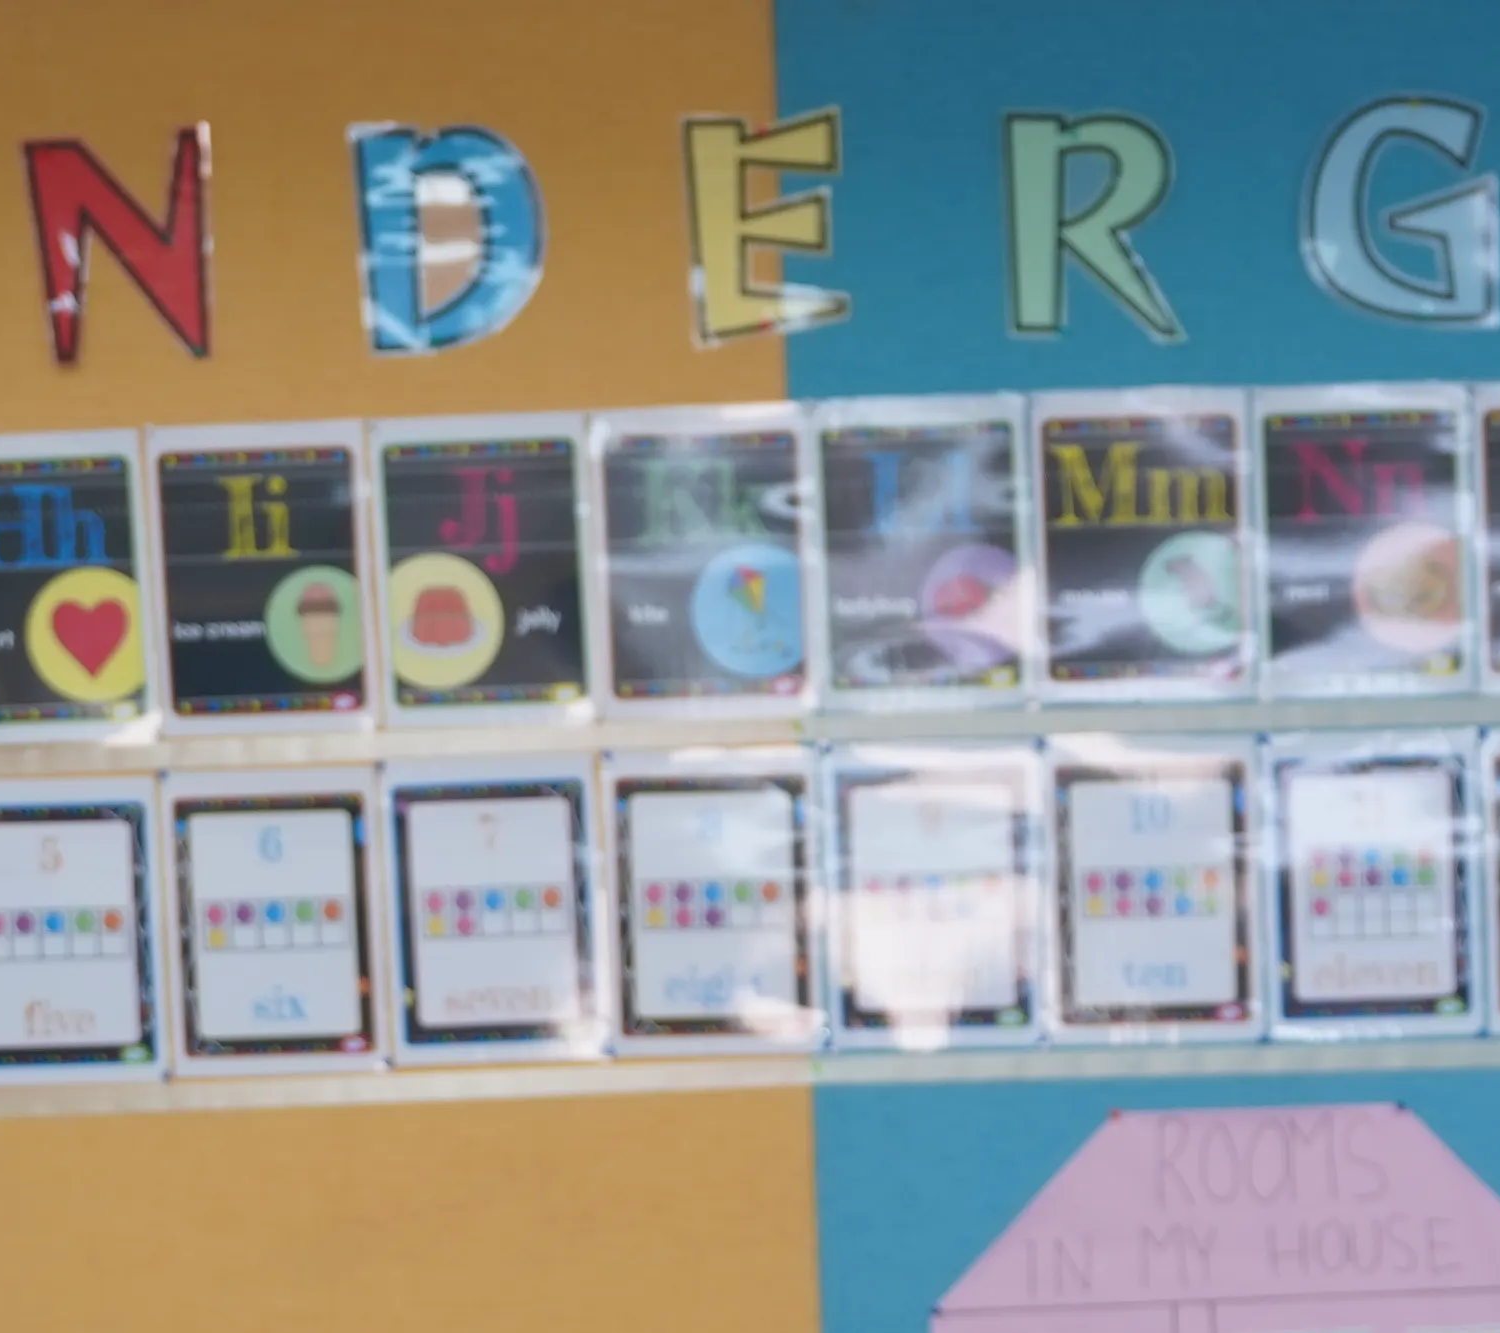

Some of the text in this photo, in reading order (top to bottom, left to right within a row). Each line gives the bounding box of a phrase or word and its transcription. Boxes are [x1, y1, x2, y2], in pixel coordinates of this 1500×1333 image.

[219, 476, 296, 559] Ii
[439, 469, 518, 574] Jj
[1049, 443, 1232, 527] Mm
[1293, 439, 1424, 522] Nn
[260, 827, 284, 863] 6
[1121, 958, 1188, 988] ten
[1157, 1112, 1389, 1208] ROOMS
[1026, 1214, 1463, 1297] IN MY HOUSE
